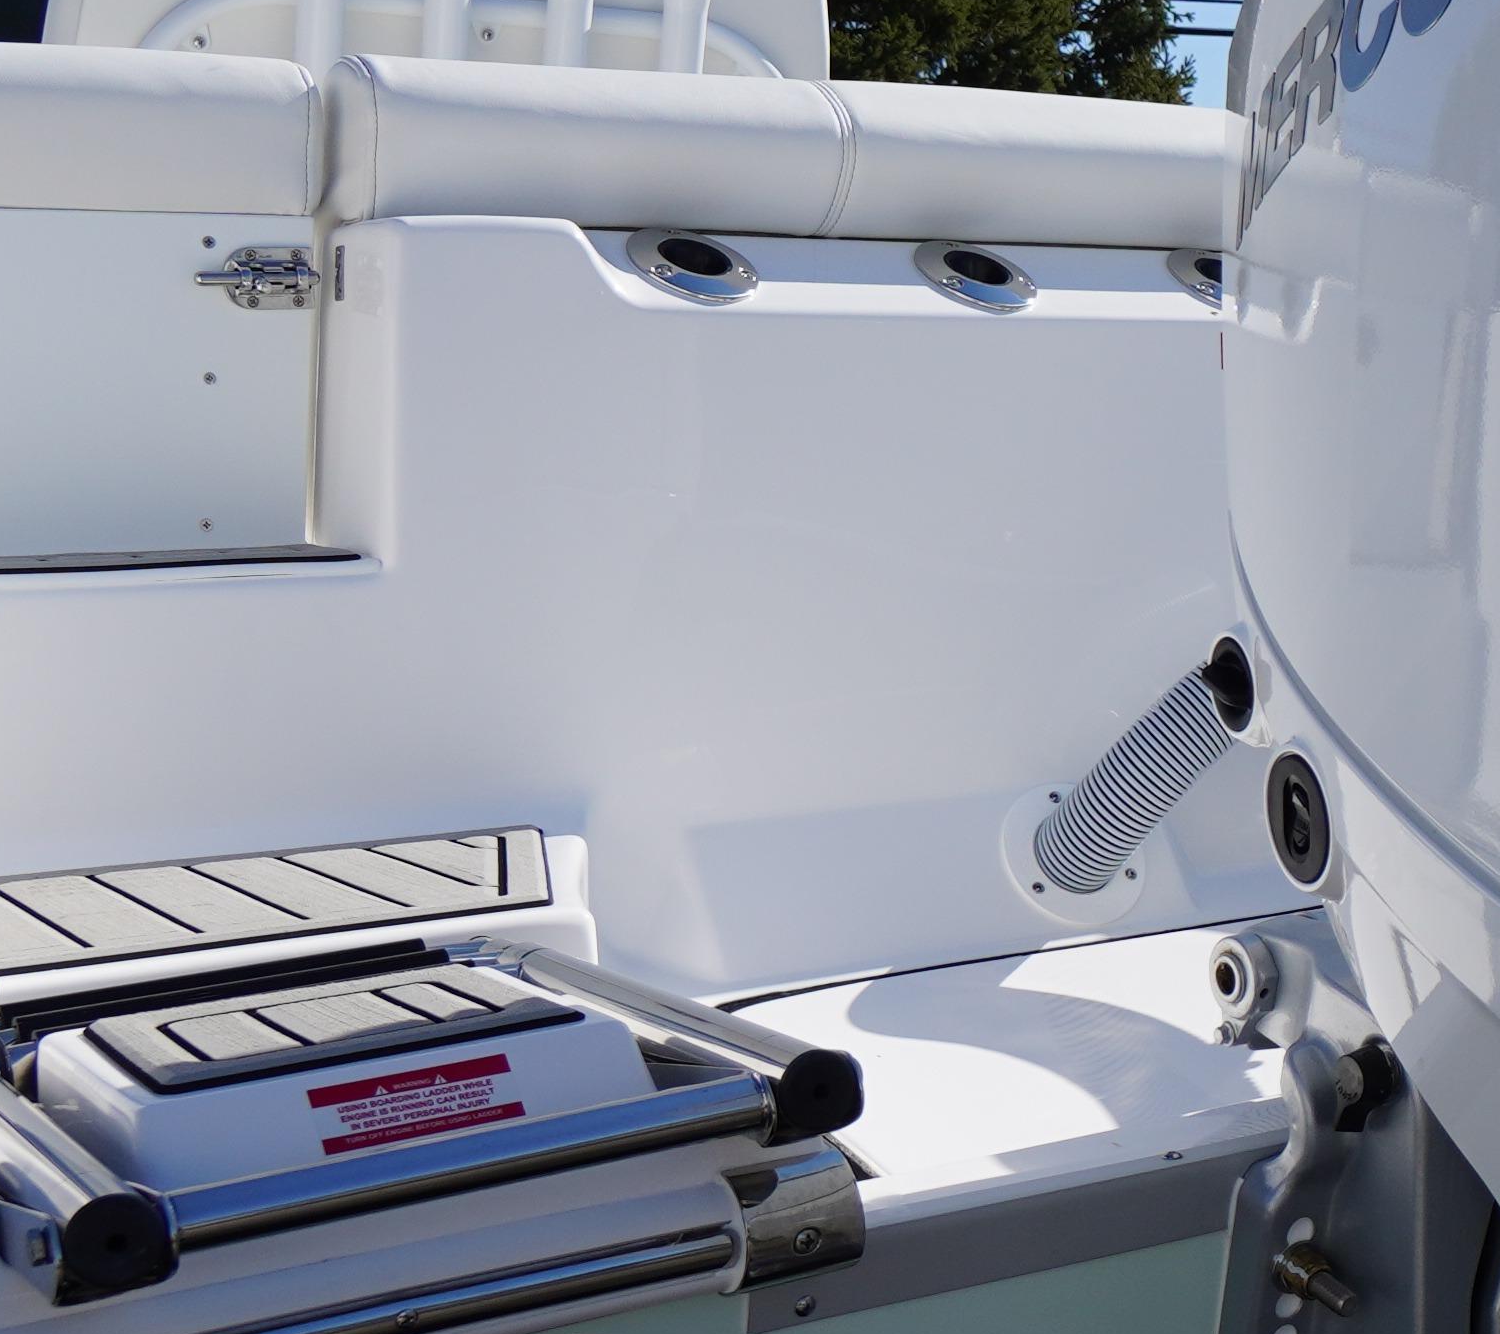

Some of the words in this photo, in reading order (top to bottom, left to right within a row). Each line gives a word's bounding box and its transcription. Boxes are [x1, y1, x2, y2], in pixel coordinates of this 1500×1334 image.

[337, 1102, 367, 1114] USING
[370, 1092, 420, 1108] BOARDING
[423, 1084, 460, 1098] LADDER
[462, 1078, 493, 1090] WHILE
[392, 1078, 431, 1090] WARNING
[340, 1110, 377, 1123] ENGINE
[379, 1108, 389, 1116] IS
[391, 1100, 434, 1113] RUNNING
[436, 1095, 457, 1105] CAN
[458, 1087, 494, 1100] RESULT
[351, 1123, 361, 1131] IN
[363, 1115, 402, 1128] SEVERE
[403, 1105, 455, 1120] PERSONAL
[457, 1097, 490, 1110] INJURY
[345, 1134, 367, 1144] TURN
[368, 1131, 383, 1140] OFF
[385, 1125, 414, 1136] ENGINE
[415, 1120, 446, 1130] BEFORE
[448, 1114, 472, 1124] USING
[473, 1108, 503, 1119] LADDER
